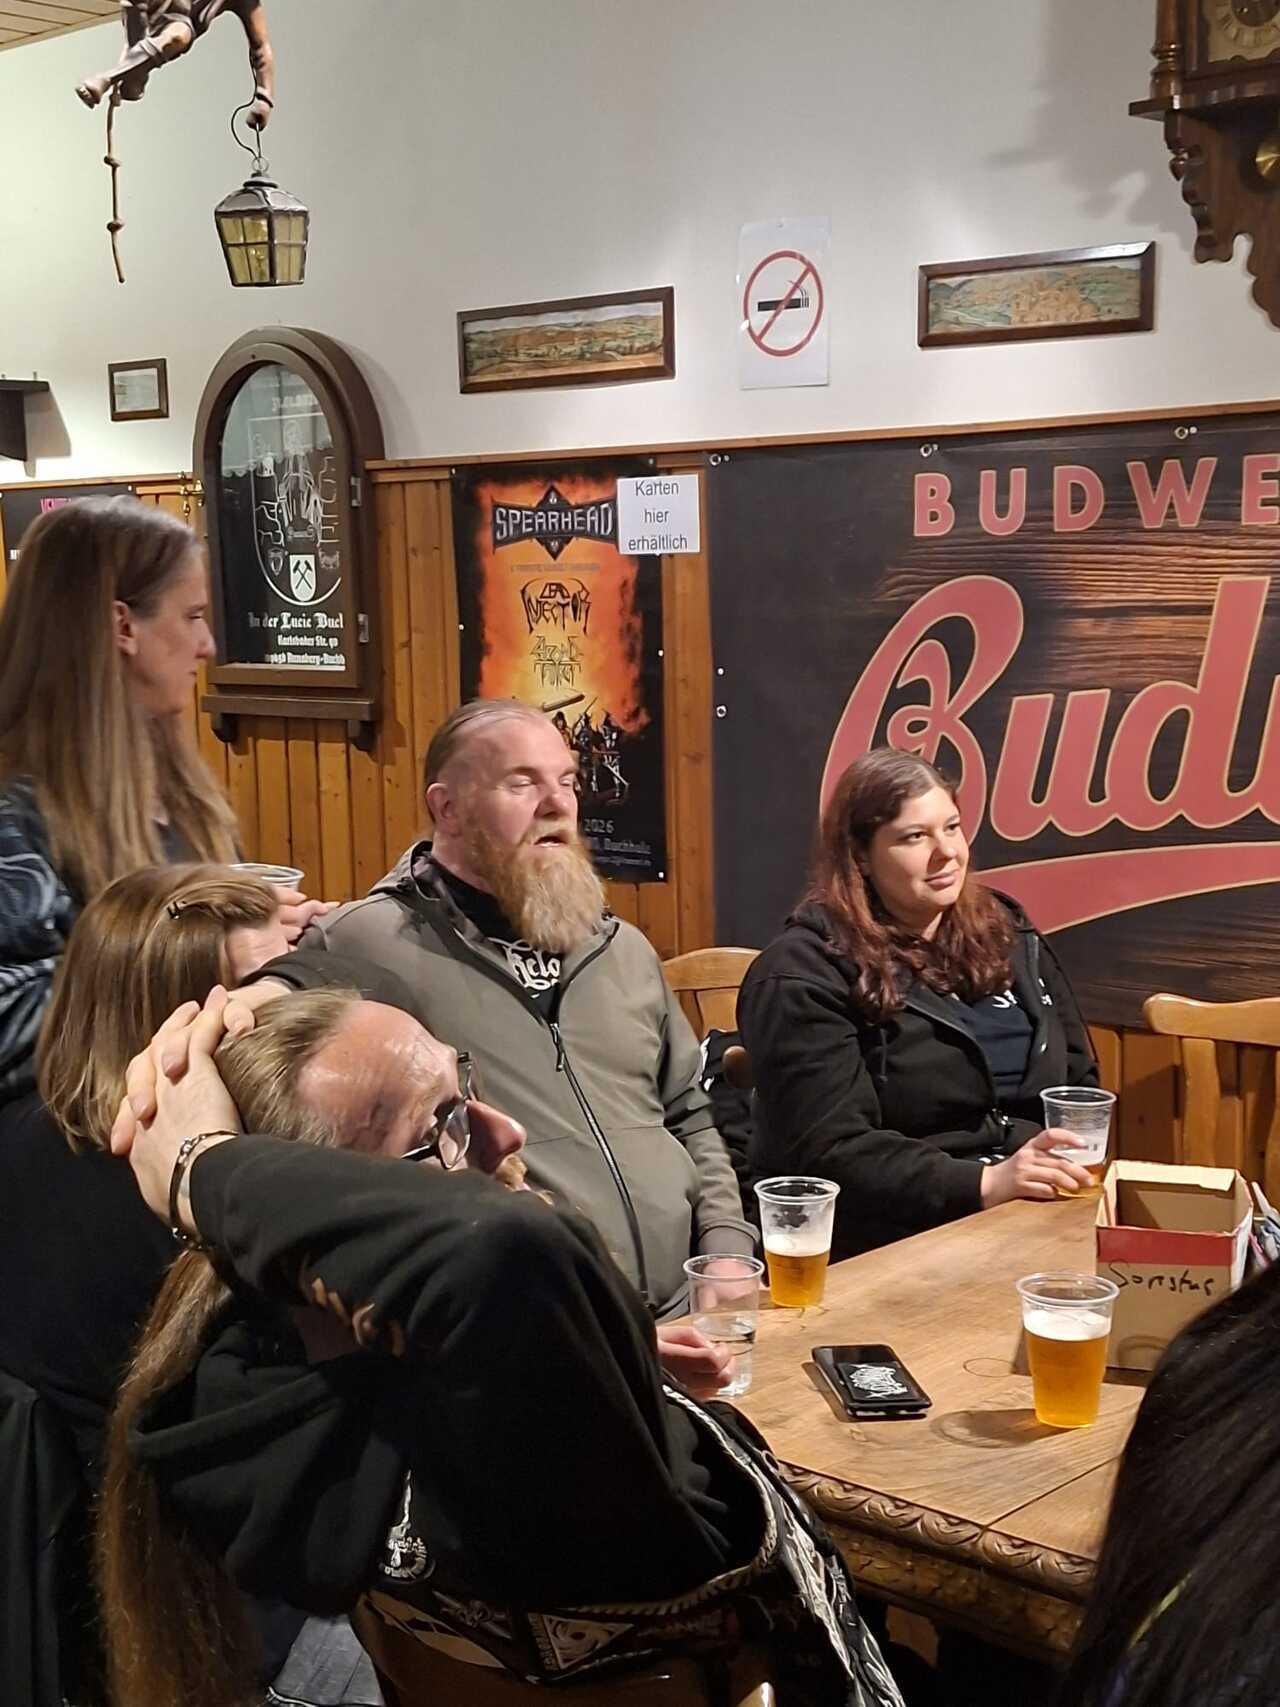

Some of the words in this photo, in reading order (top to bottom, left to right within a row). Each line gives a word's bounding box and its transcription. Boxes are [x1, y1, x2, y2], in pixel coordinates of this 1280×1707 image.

[635, 479, 680, 497] Karten
[495, 503, 613, 541] SPEARHEAD
[644, 509, 670, 523] hier
[628, 534, 688, 551] erhältlich
[262, 612, 278, 628] der
